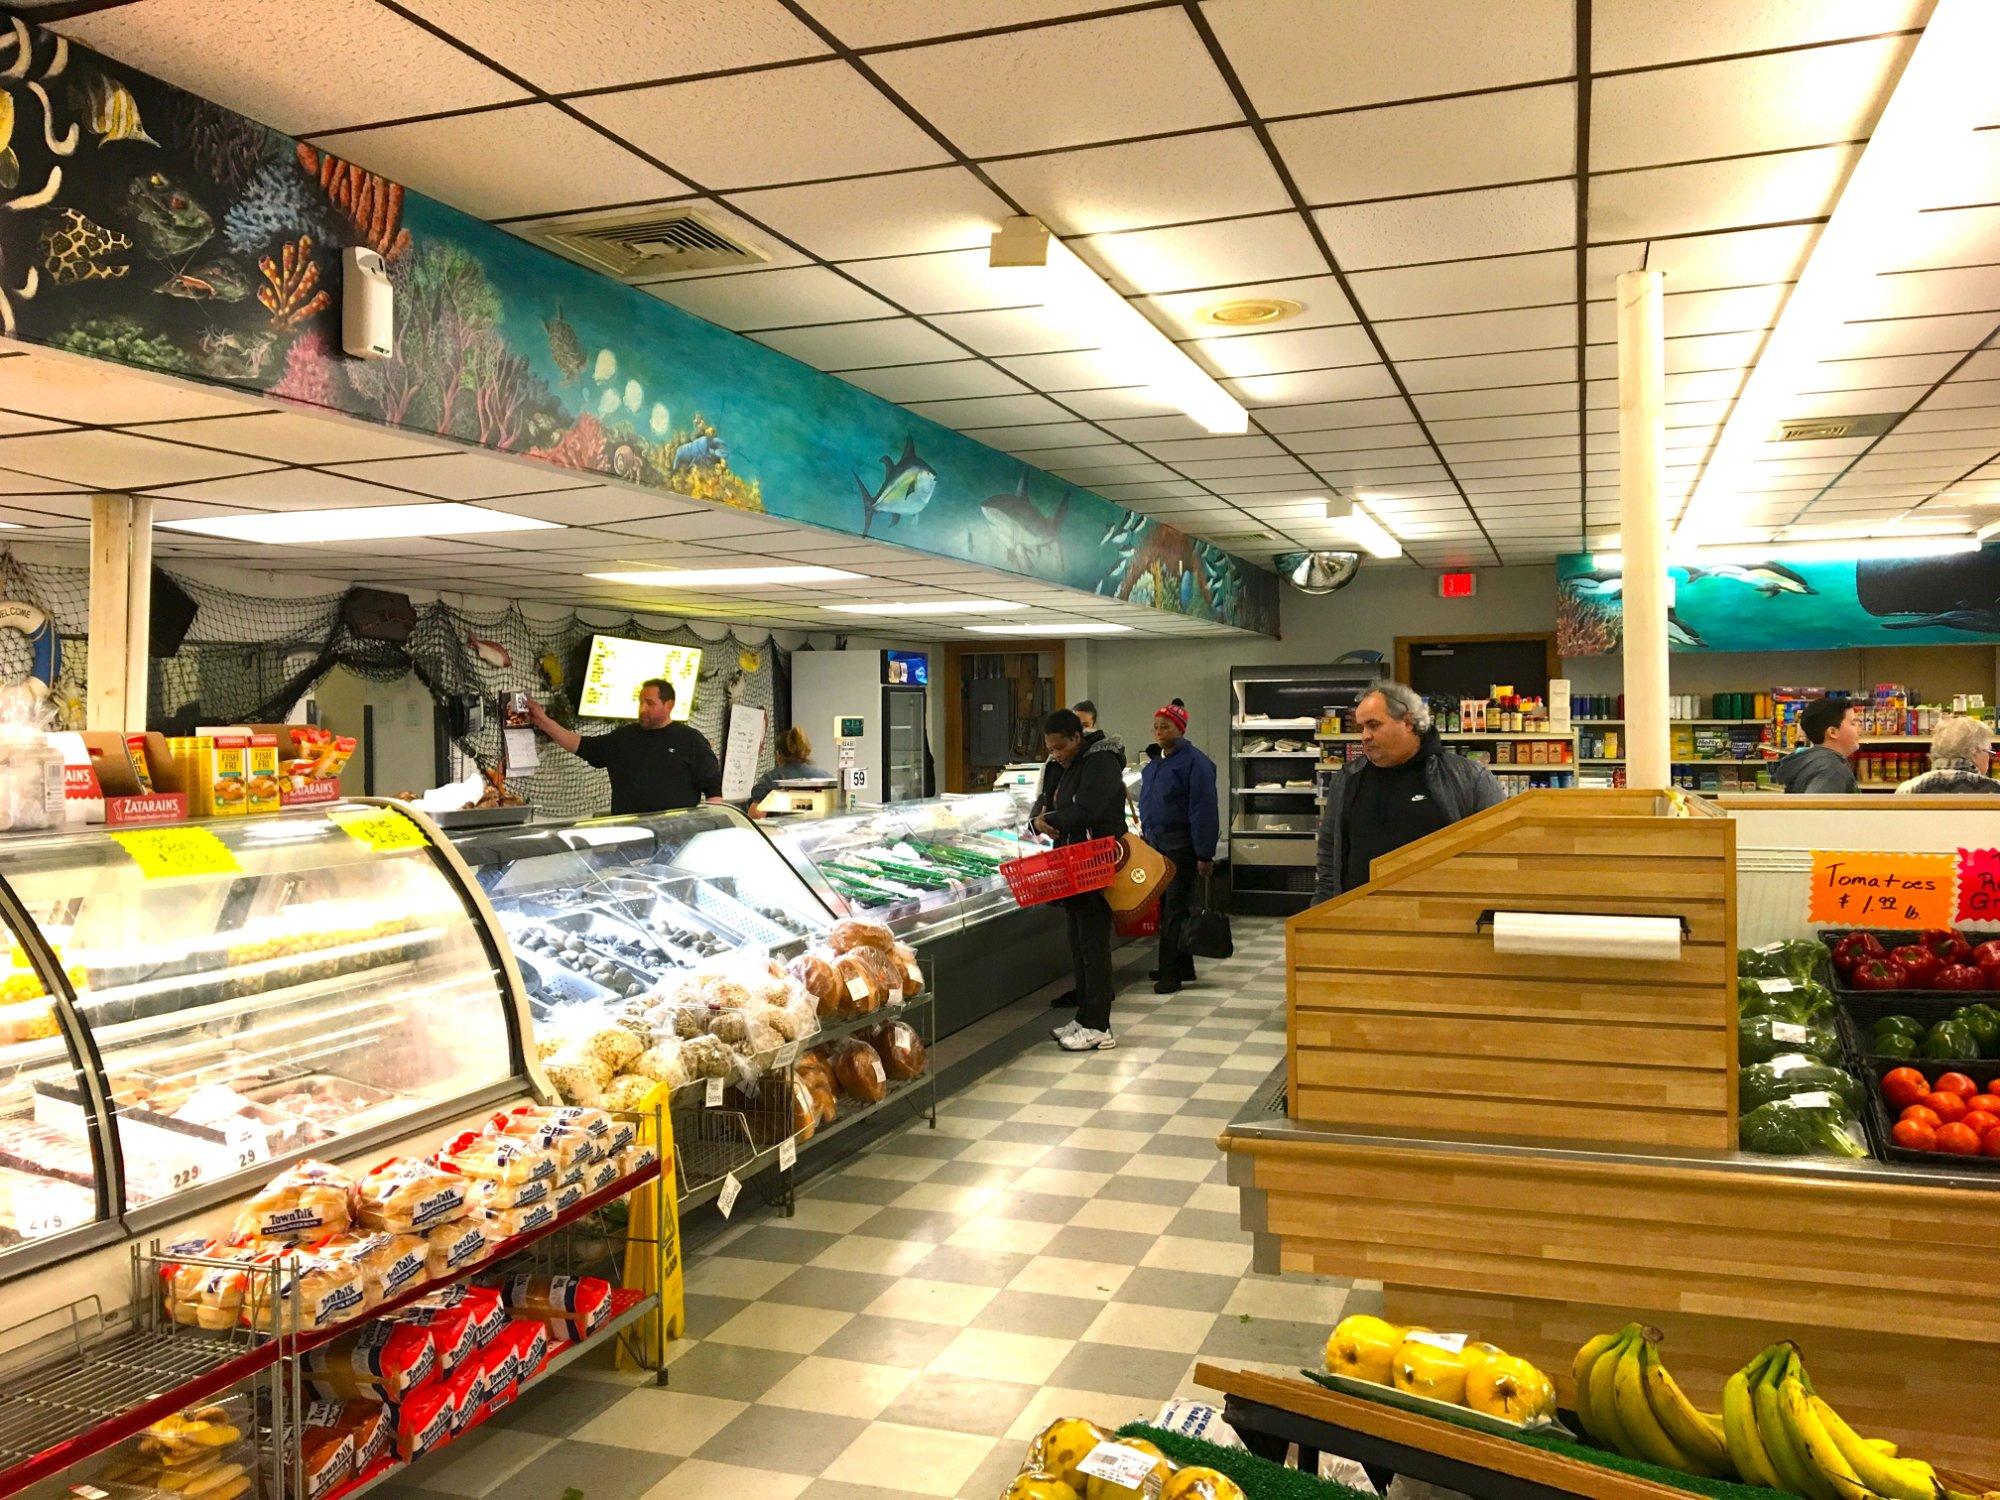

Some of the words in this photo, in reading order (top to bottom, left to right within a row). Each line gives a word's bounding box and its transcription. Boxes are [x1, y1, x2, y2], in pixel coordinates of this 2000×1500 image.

[0, 606, 31, 619] ELCOME
[221, 753, 239, 762] FISH
[255, 751, 272, 761] FISH
[224, 762, 237, 770] FRI
[258, 760, 270, 769] FRI
[853, 771, 866, 787] 59
[1825, 862, 1937, 891] Tomatoes
